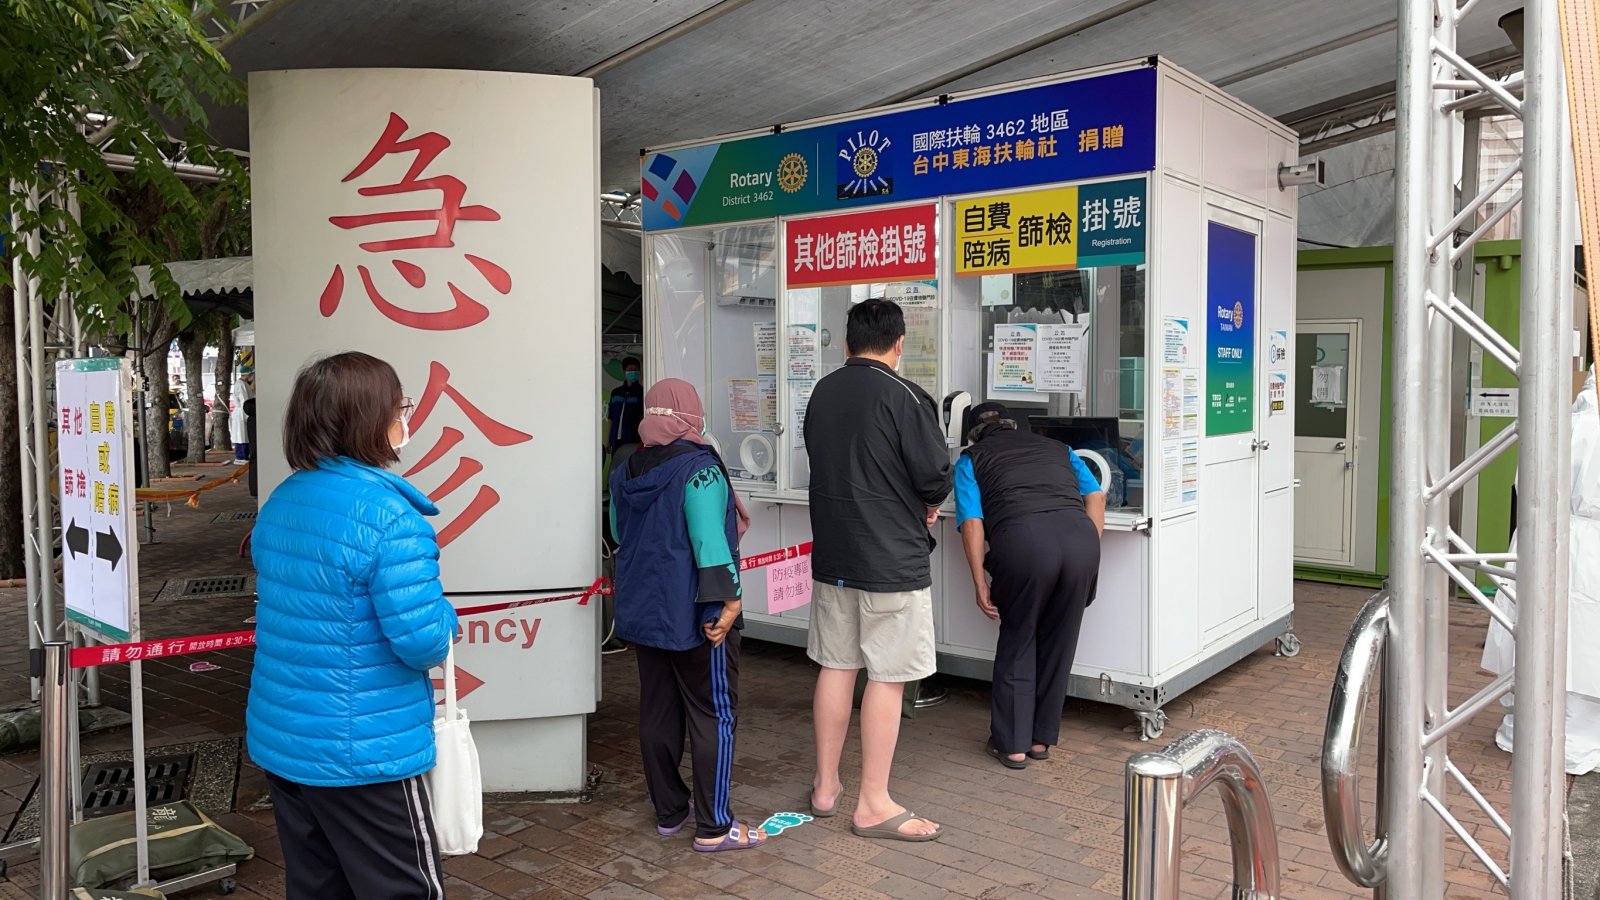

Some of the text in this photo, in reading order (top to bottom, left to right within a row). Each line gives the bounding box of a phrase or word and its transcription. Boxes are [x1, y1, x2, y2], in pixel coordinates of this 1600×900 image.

[839, 130, 892, 161] PILOT
[913, 108, 1070, 153] 國際扶輪 3462 地區
[913, 125, 1124, 176] 台中東海扶輪社 捐贈
[730, 170, 773, 188] Rotary
[722, 191, 774, 207] District 3462
[964, 202, 1011, 232] 自費
[1082, 196, 1141, 233] 掛號
[1018, 212, 1072, 248] 篩檢
[1091, 237, 1132, 247] Registration
[794, 223, 927, 272] 其他篩檢掛號
[964, 237, 1011, 269] 陪病
[1217, 305, 1233, 322] Rotary
[1217, 347, 1243, 359] STAFF ONLY
[62, 406, 82, 435] 其他
[89, 401, 116, 433] 自費
[98, 441, 110, 474] 或
[64, 468, 86, 498] 篩檢
[772, 561, 809, 582] 防疫專區
[102, 640, 185, 663] 請勿通行
[188, 640, 223, 650] 開放時間
